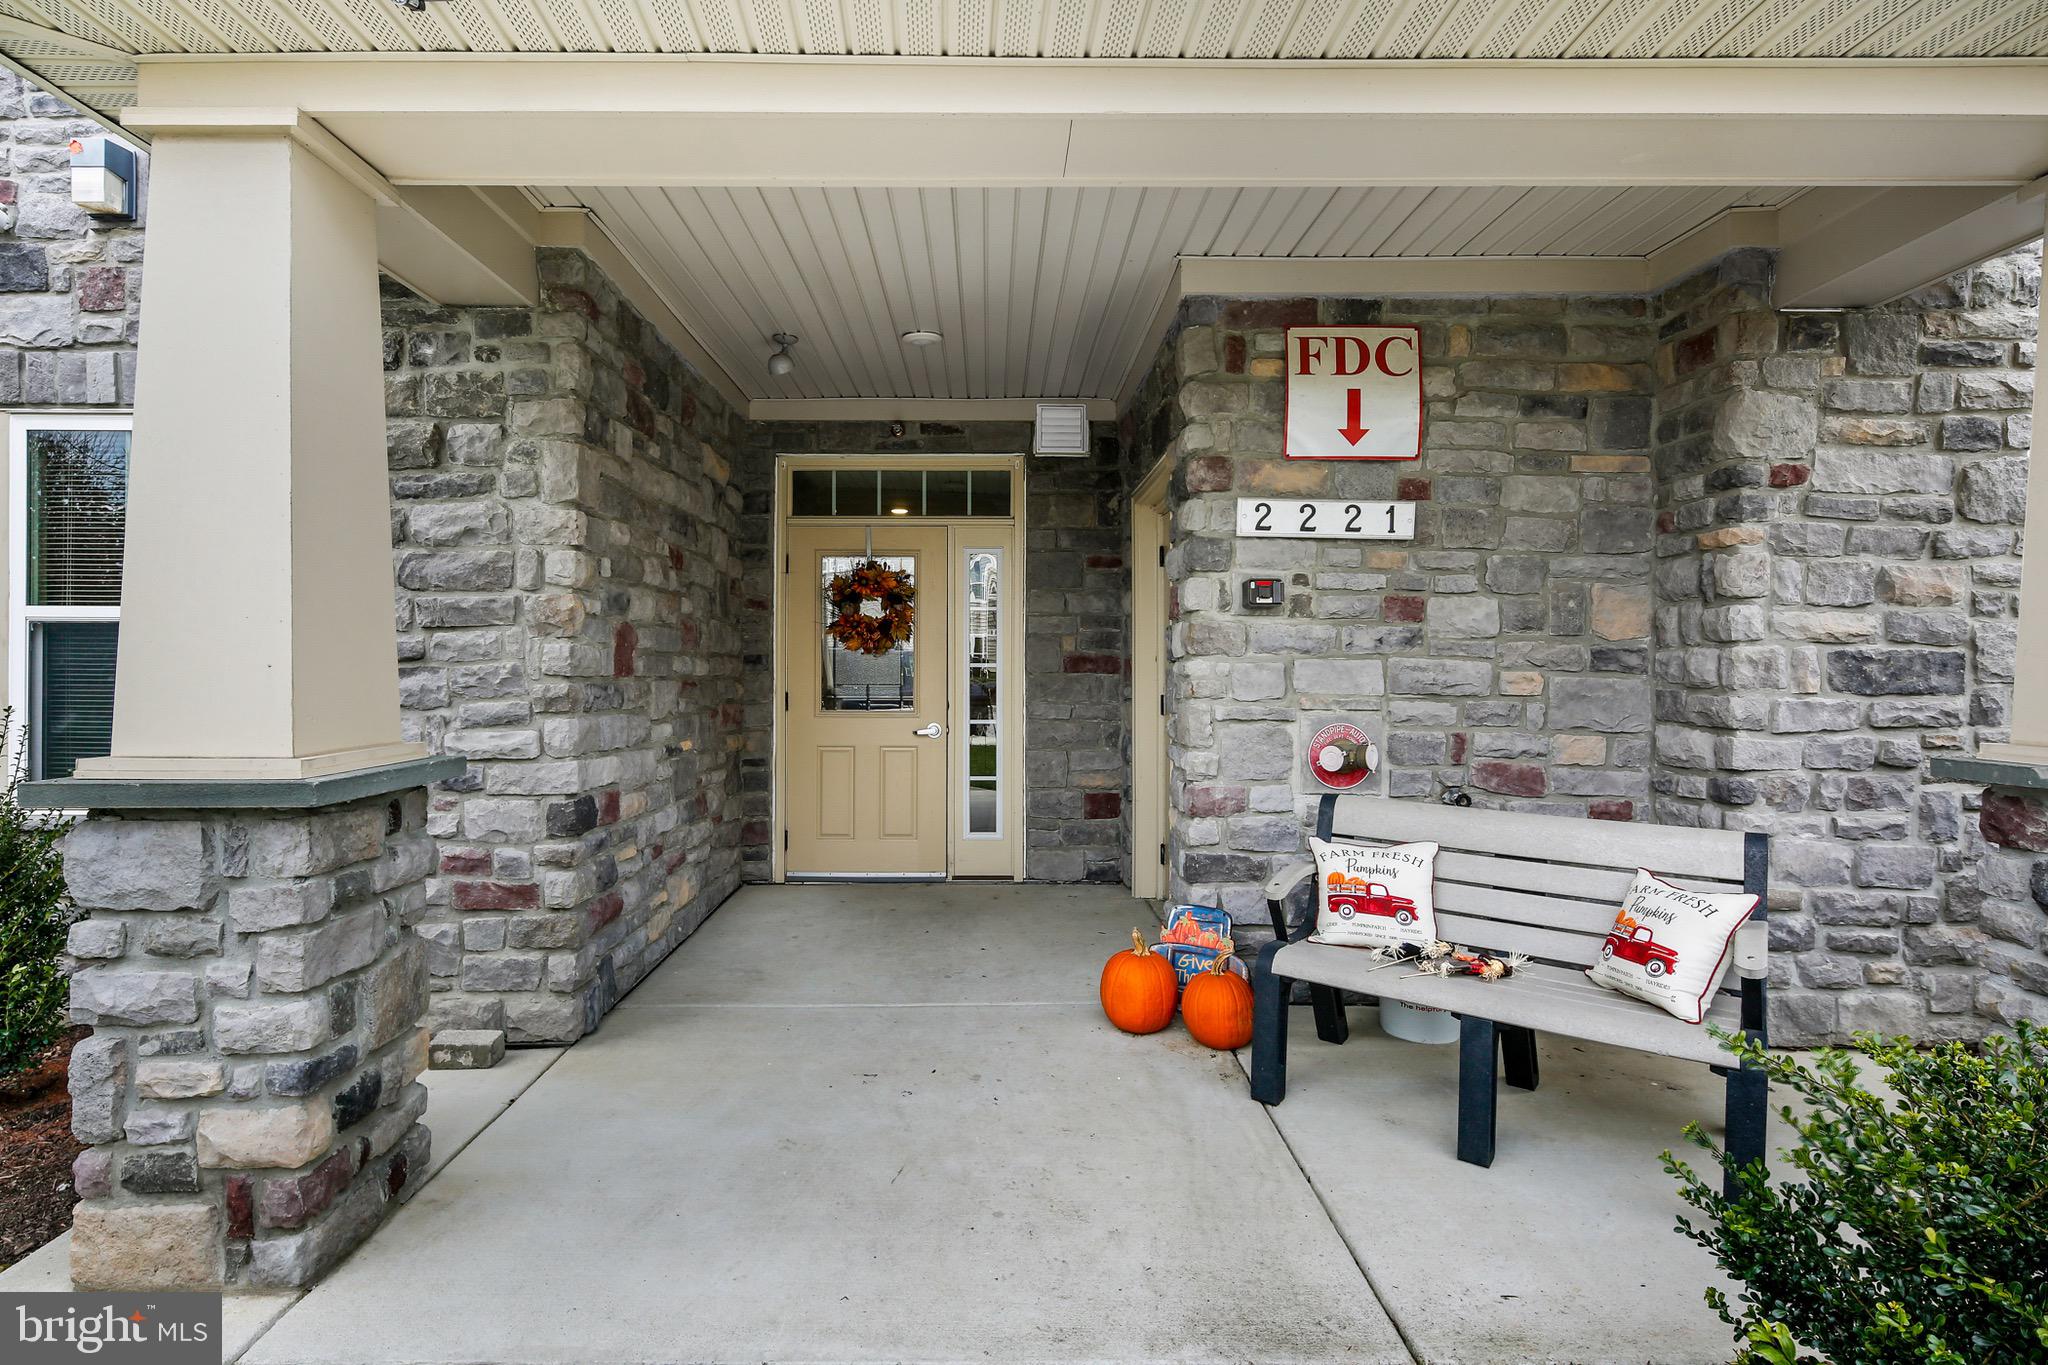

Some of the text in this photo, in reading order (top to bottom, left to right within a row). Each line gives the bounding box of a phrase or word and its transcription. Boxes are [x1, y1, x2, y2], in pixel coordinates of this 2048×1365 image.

[1294, 336, 1413, 377] FDC
[1319, 848, 1424, 868] FARM FRESH
[1345, 857, 1399, 879] Pumpkins
[1629, 884, 1719, 918] ARM FRESH
[1629, 896, 1678, 925] Pumpkins
[1178, 954, 1213, 970] Give
